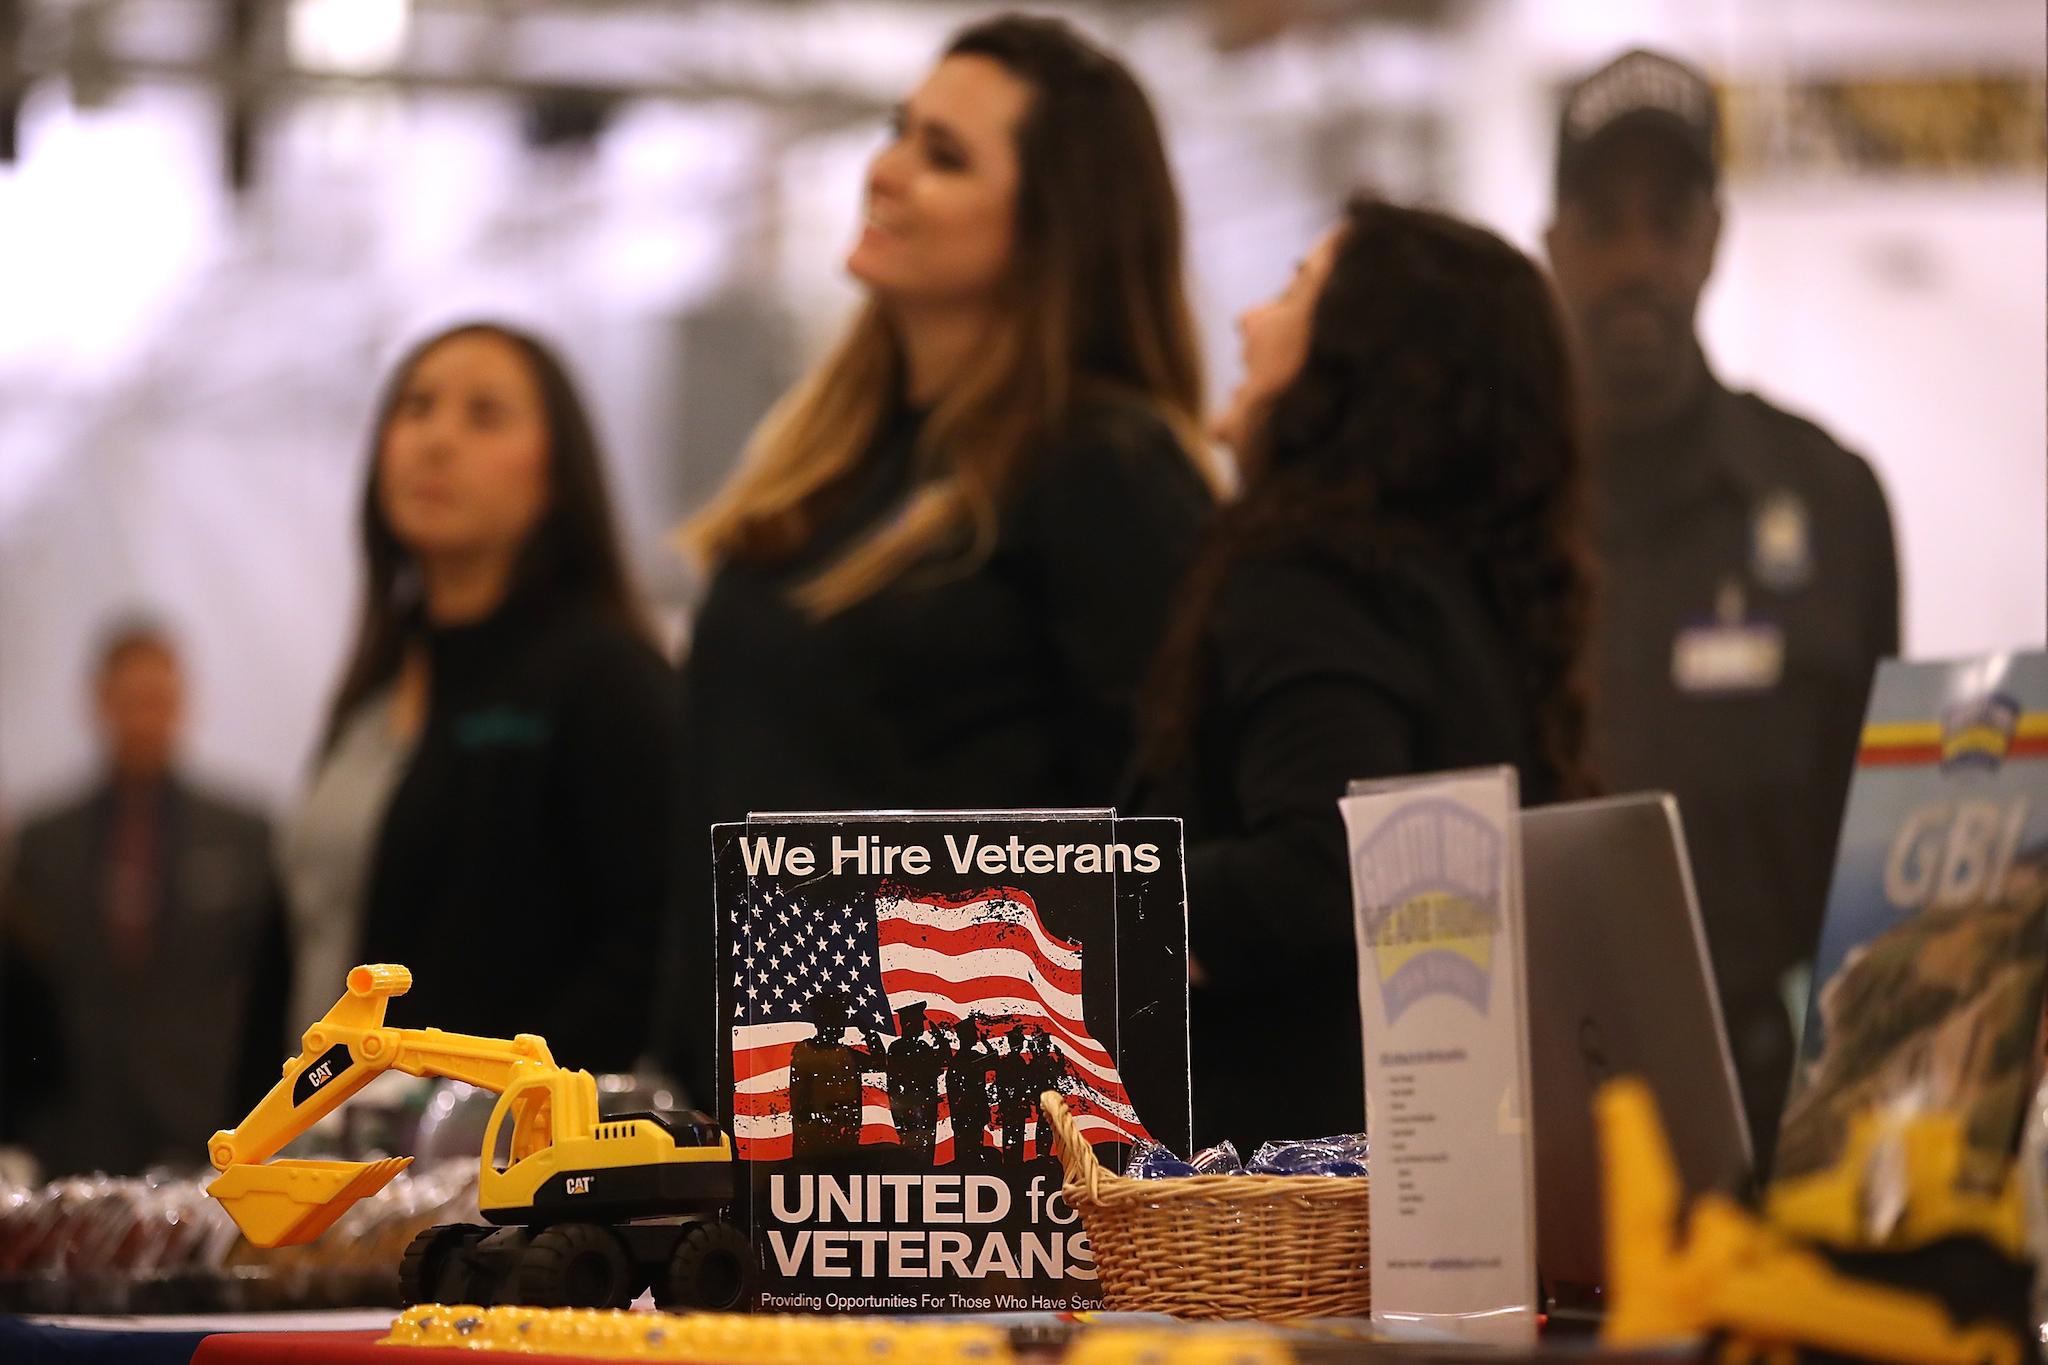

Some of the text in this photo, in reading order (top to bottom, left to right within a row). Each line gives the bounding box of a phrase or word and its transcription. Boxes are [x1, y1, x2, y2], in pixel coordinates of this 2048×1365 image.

[739, 835, 1160, 876] We Hire Veterans
[308, 1061, 333, 1087] CAT
[566, 1177, 590, 1195] CAT
[770, 1175, 1079, 1225] UNITED fo
[766, 1231, 1098, 1280] VETERANS
[761, 1293, 821, 1311] Providing
[826, 1293, 917, 1311] Opportunities
[922, 1293, 945, 1308] For
[949, 1294, 991, 1309] Those
[995, 1295, 1027, 1309] Who
[1031, 1295, 1067, 1309] Have
